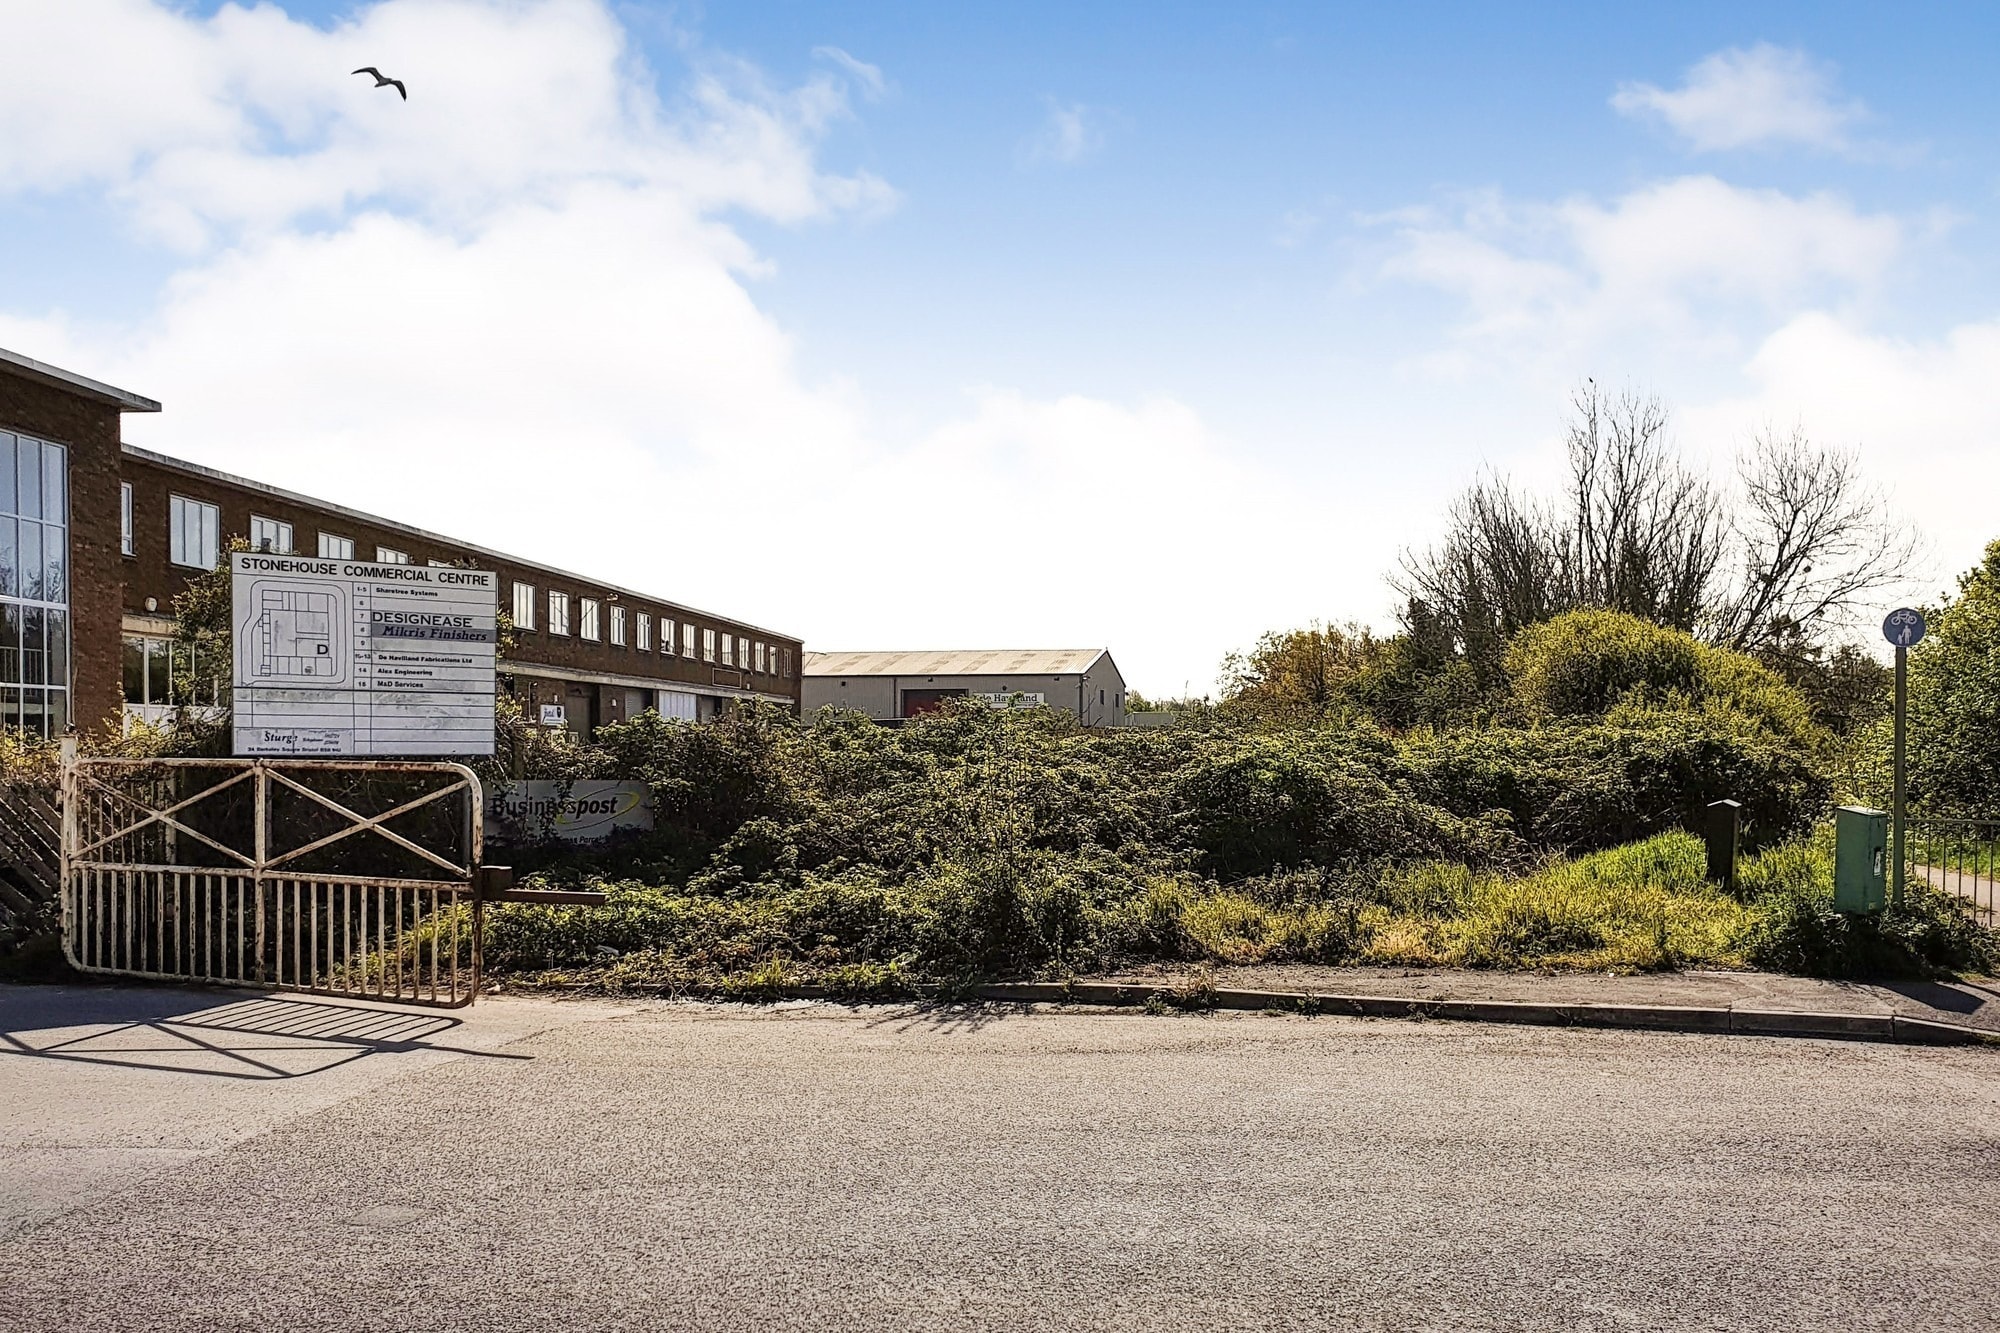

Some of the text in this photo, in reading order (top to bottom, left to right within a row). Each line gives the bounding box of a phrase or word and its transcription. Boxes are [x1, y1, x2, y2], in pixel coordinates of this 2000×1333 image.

[241, 557, 489, 586] STONEHOUSE COMMERCIAL CENTRE
[372, 611, 473, 628] DESIGNEASE
[382, 625, 426, 638] Mikris
[430, 628, 487, 641] Finishers
[316, 644, 328, 655] D
[394, 669, 433, 677] Engineering
